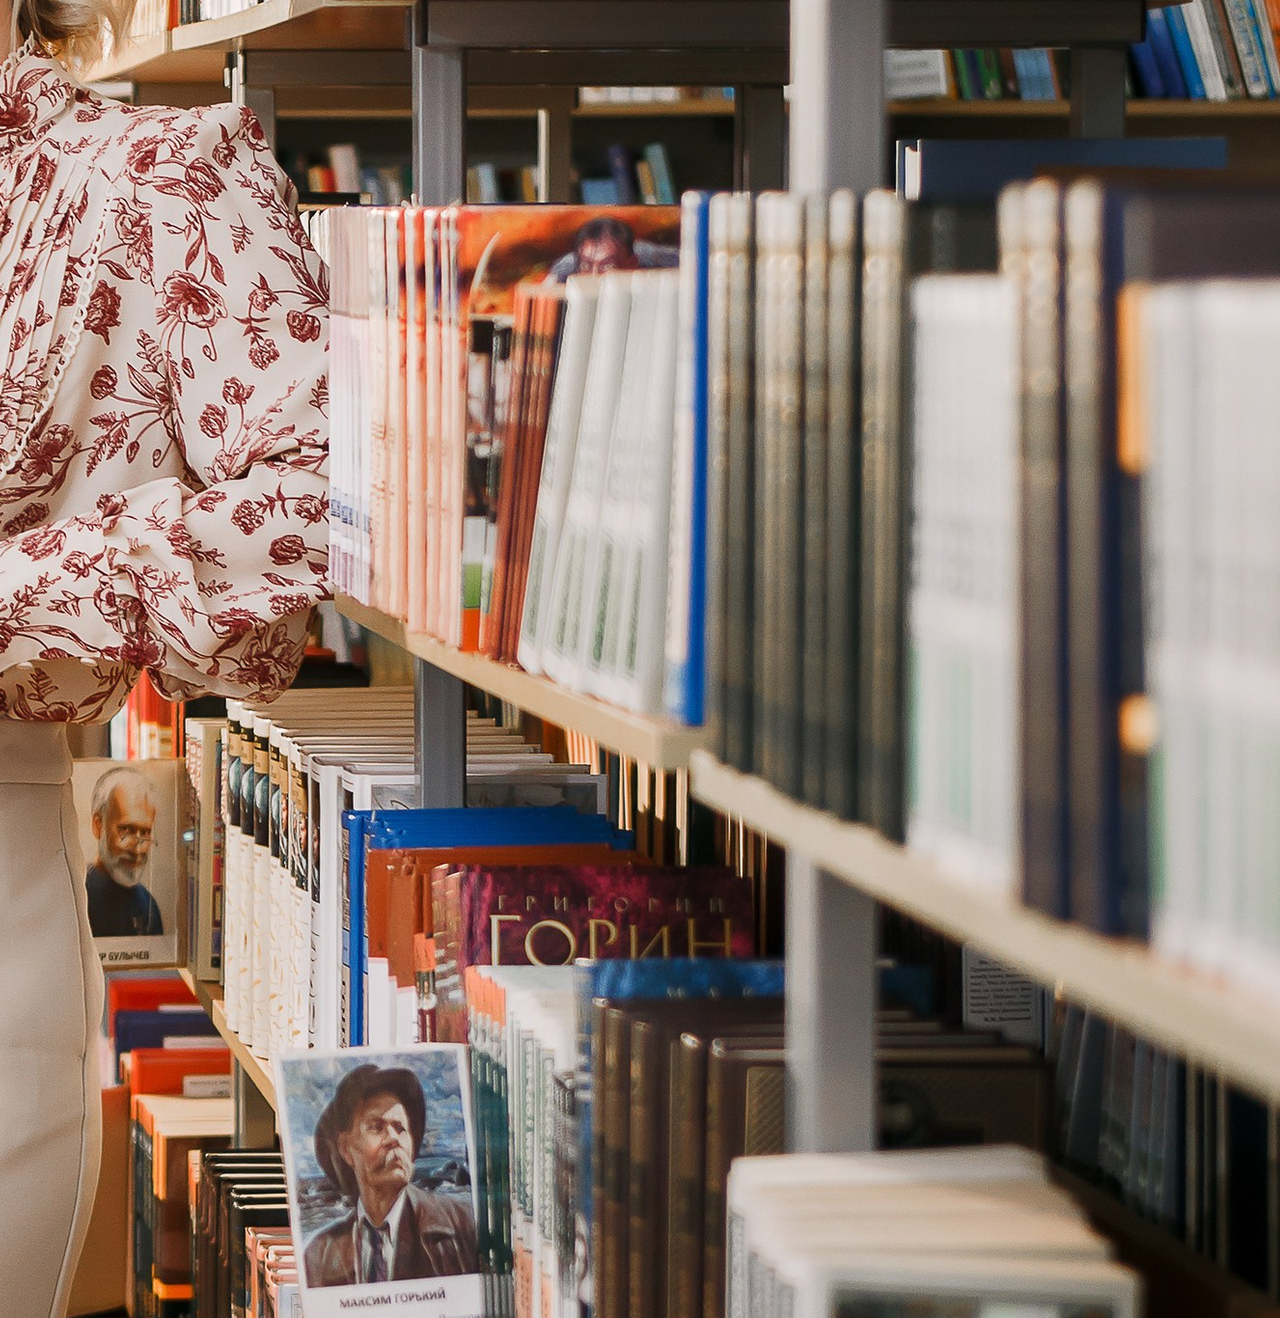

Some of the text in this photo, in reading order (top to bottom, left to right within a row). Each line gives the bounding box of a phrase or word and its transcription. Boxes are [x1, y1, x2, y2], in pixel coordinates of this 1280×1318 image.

[490, 914, 732, 966] ГОРИН
[108, 951, 150, 960] БУЛЫЧЕВ
[340, 1287, 446, 1308] МАКСИМ ГОРЬКИЙ
